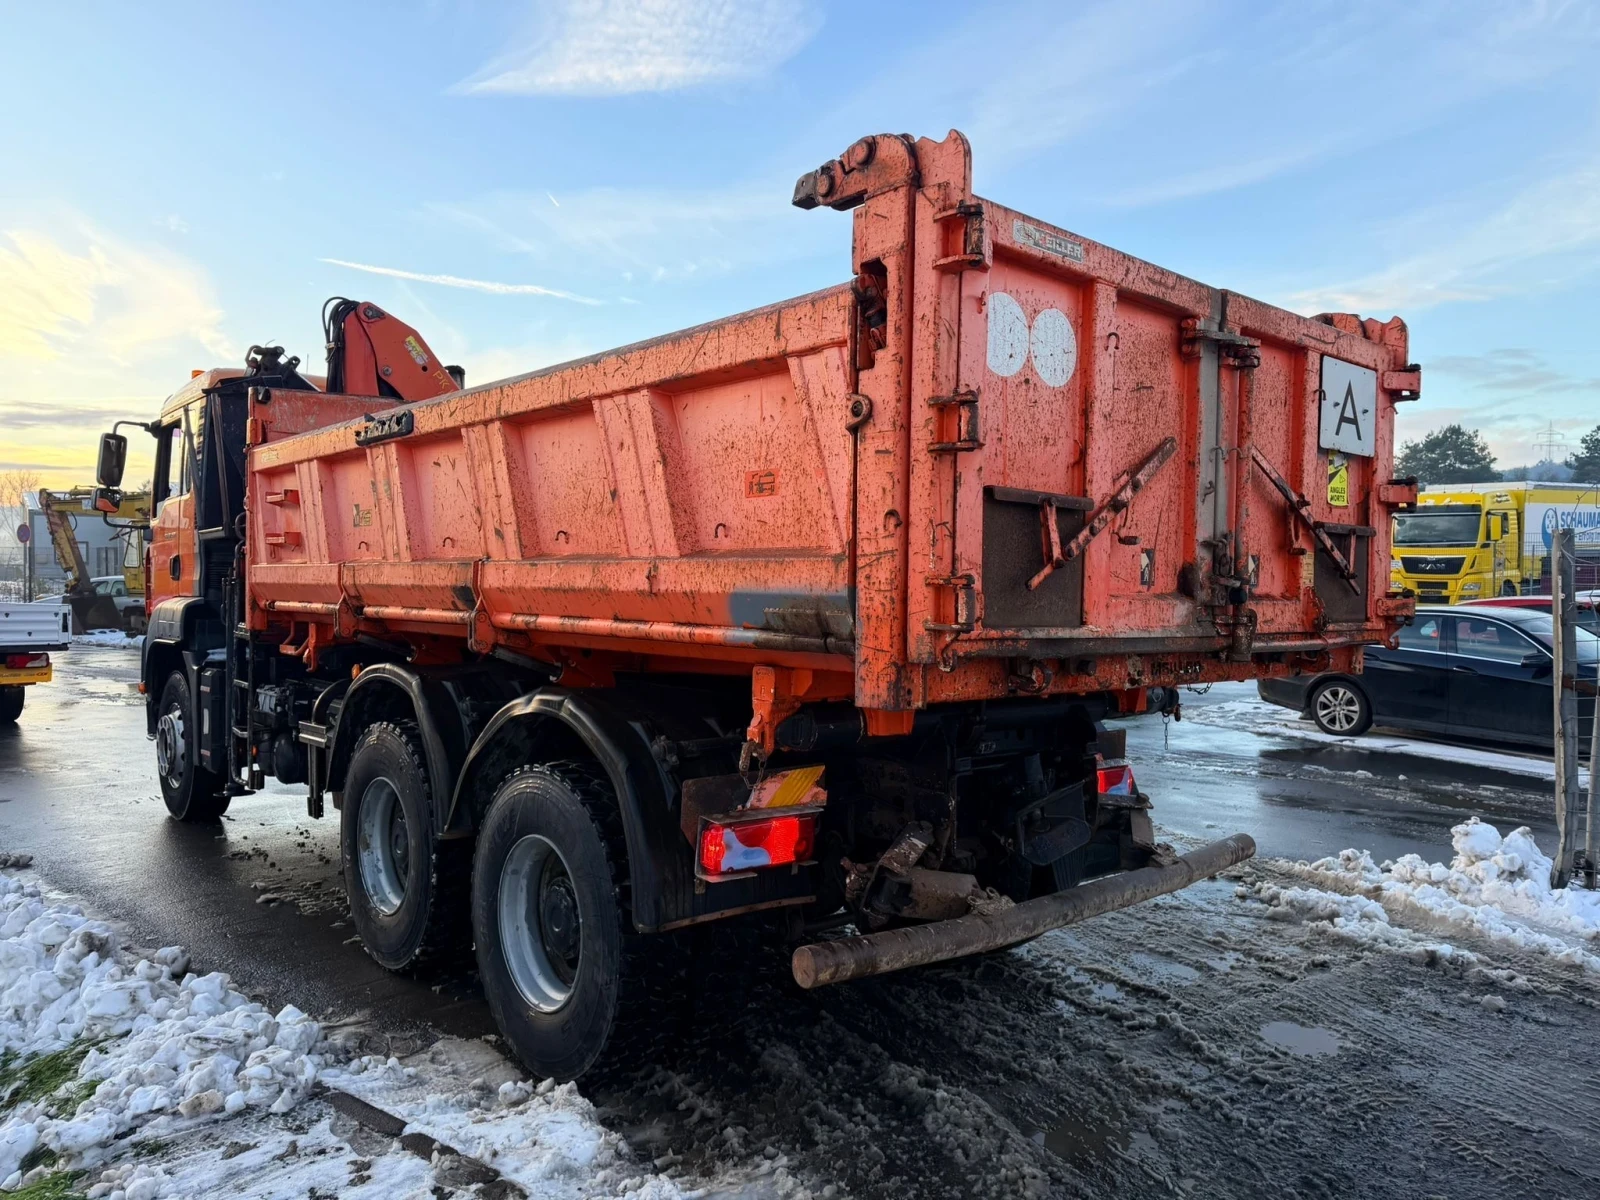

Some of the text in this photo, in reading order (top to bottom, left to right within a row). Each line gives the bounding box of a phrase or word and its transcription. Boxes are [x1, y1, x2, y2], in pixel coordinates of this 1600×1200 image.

[432, 370, 450, 389] PK
[1335, 379, 1362, 441] A
[1330, 486, 1346, 494] ANGLES
[1330, 494, 1345, 502] MORTS
